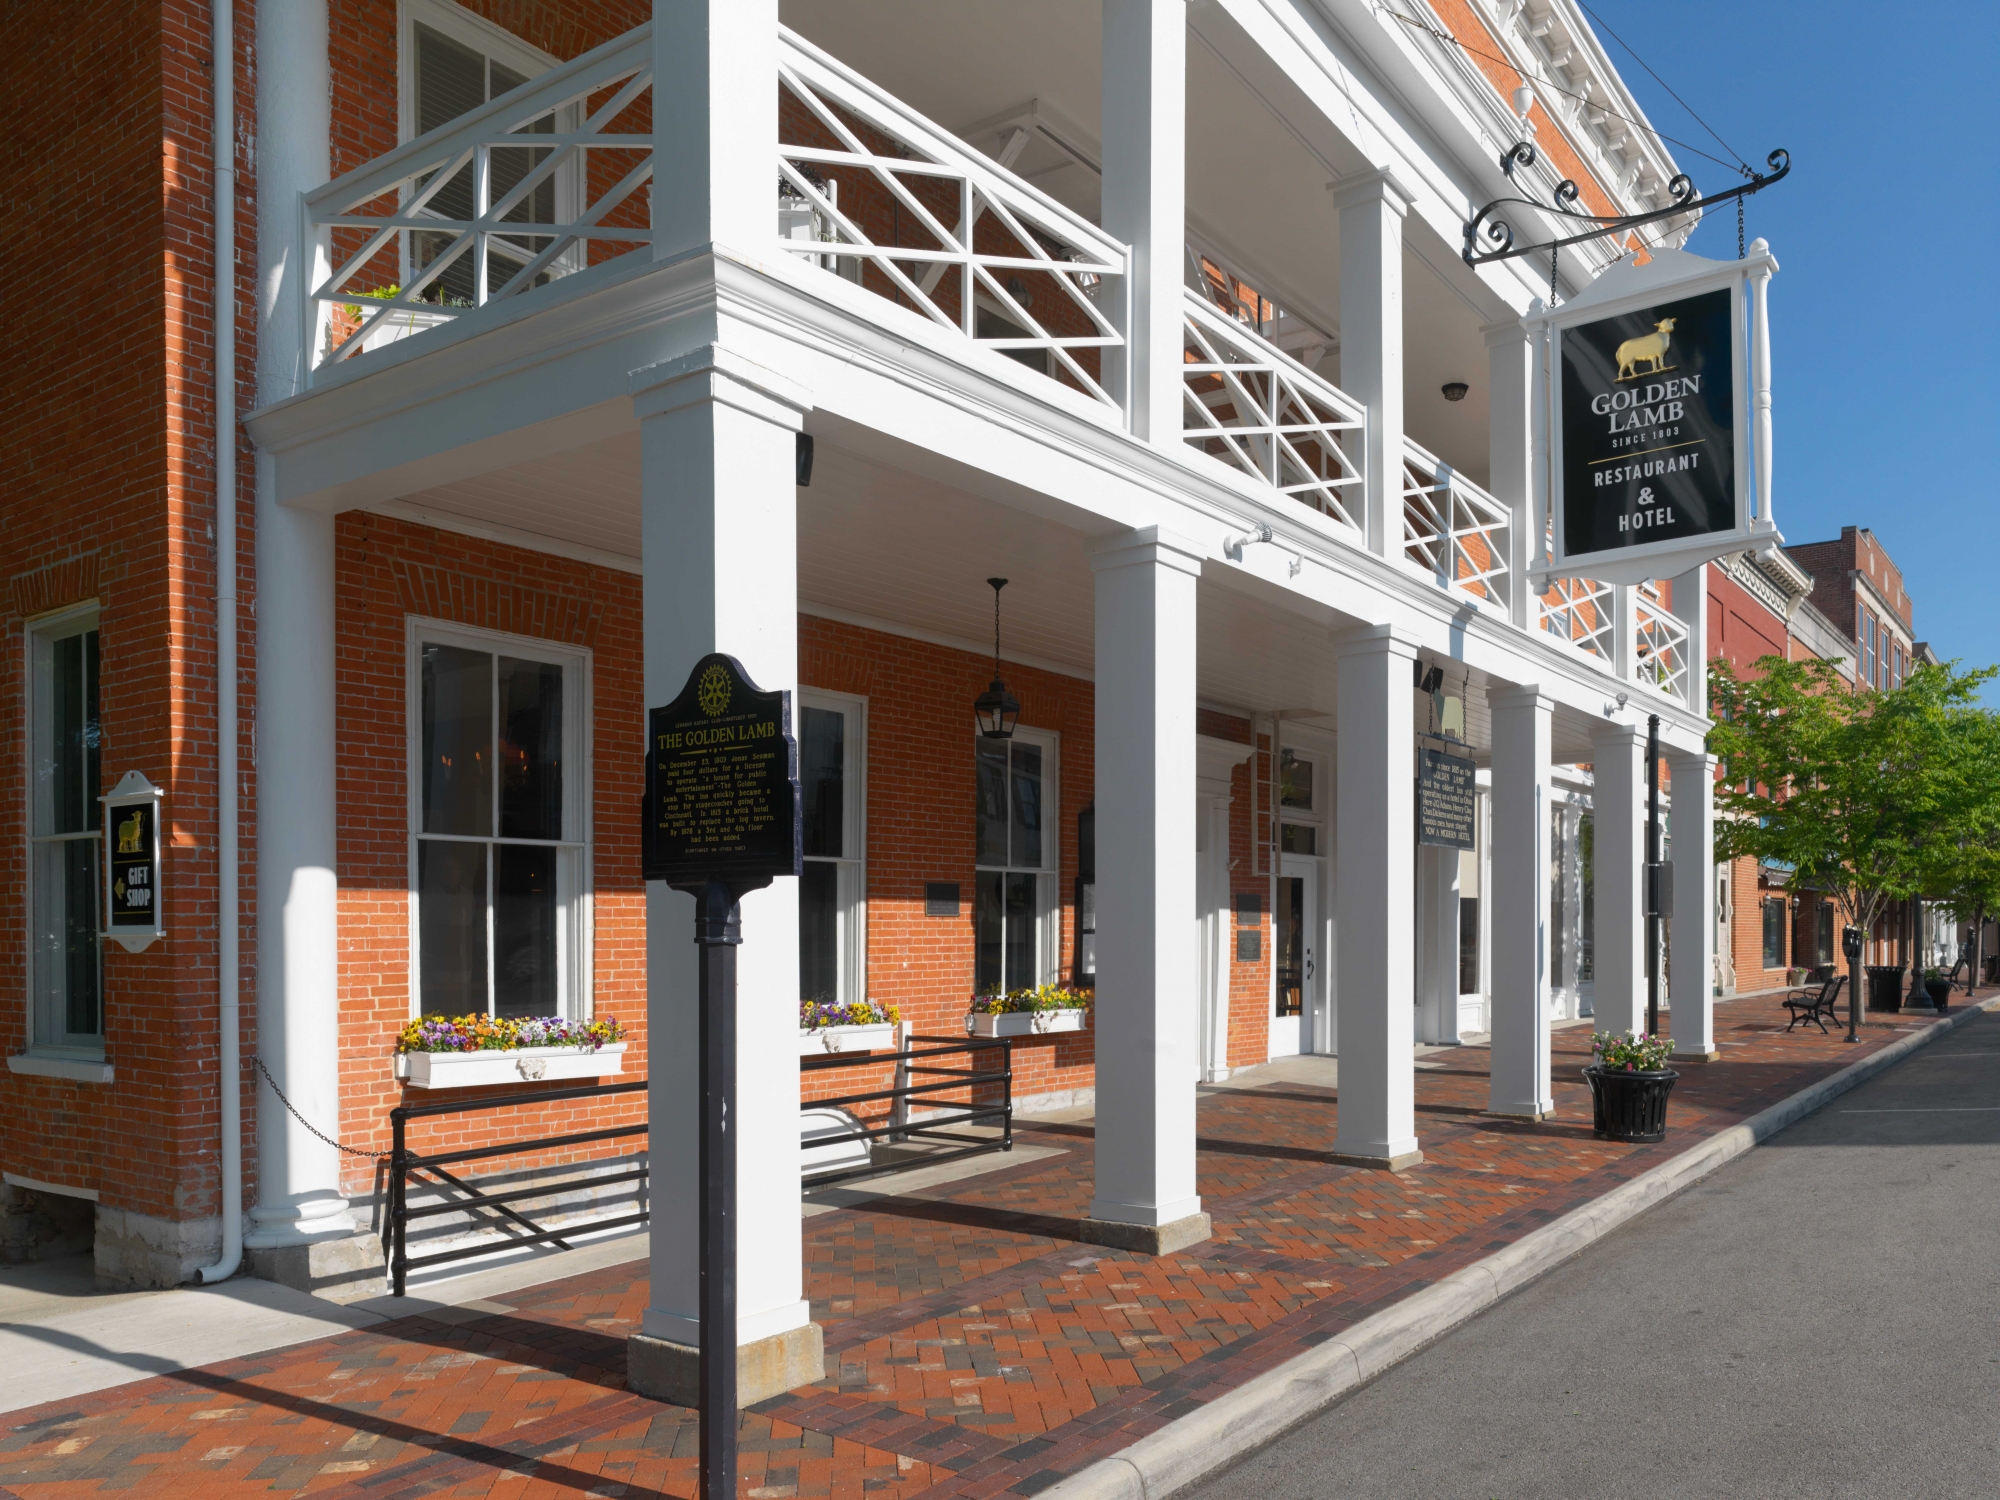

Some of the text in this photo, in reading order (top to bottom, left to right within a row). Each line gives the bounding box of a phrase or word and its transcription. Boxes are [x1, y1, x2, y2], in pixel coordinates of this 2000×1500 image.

[1591, 374, 1701, 416] GOLDEN
[1608, 401, 1684, 434] LAMB
[1612, 426, 1680, 448] SINCE 1803
[1594, 453, 1699, 487] RESTAURANT
[1637, 486, 1655, 505] &
[1618, 507, 1676, 532] HOTEL
[658, 721, 776, 749] THE GOLDEN LAMB
[667, 770, 680, 778] paid
[682, 768, 695, 776] four
[698, 766, 718, 774] dollars
[722, 764, 732, 772] for
[744, 762, 766, 770] license
[669, 760, 697, 769] December
[676, 777, 697, 786] operate
[713, 774, 730, 782] house
[734, 772, 744, 780] for
[748, 770, 767, 780] public
[736, 780, 757, 788] Golden
[1423, 778, 1432, 788] And
[1433, 781, 1441, 790] the
[1442, 784, 1455, 793] oldest
[684, 793, 696, 801] The
[712, 790, 735, 800] quickly
[739, 788, 762, 797] became
[1423, 790, 1442, 800] operating
[1451, 795, 1460, 804] hotel
[667, 804, 679, 812] stop
[683, 802, 692, 810] for
[695, 799, 733, 809] stagecoaches
[737, 798, 754, 807] going
[733, 806, 749, 815] brick
[753, 804, 769, 813] hotel
[1453, 803, 1464, 814] Henry
[672, 820, 686, 828] built
[699, 817, 722, 827] replace
[725, 816, 735, 824] the
[739, 815, 749, 824] log
[1423, 816, 1437, 826] famous
[1446, 821, 1456, 829] have
[669, 829, 678, 838] By
[705, 826, 717, 834] 3rd
[719, 825, 731, 833] and
[734, 824, 745, 832] 4th
[747, 823, 764, 831] floor
[1425, 827, 1436, 836] NOW
[1435, 829, 1440, 837] A
[1441, 830, 1457, 840] MODERN
[690, 835, 702, 843] had
[705, 834, 720, 842] been
[128, 867, 148, 885] GIFT
[126, 889, 150, 907] SHOP
